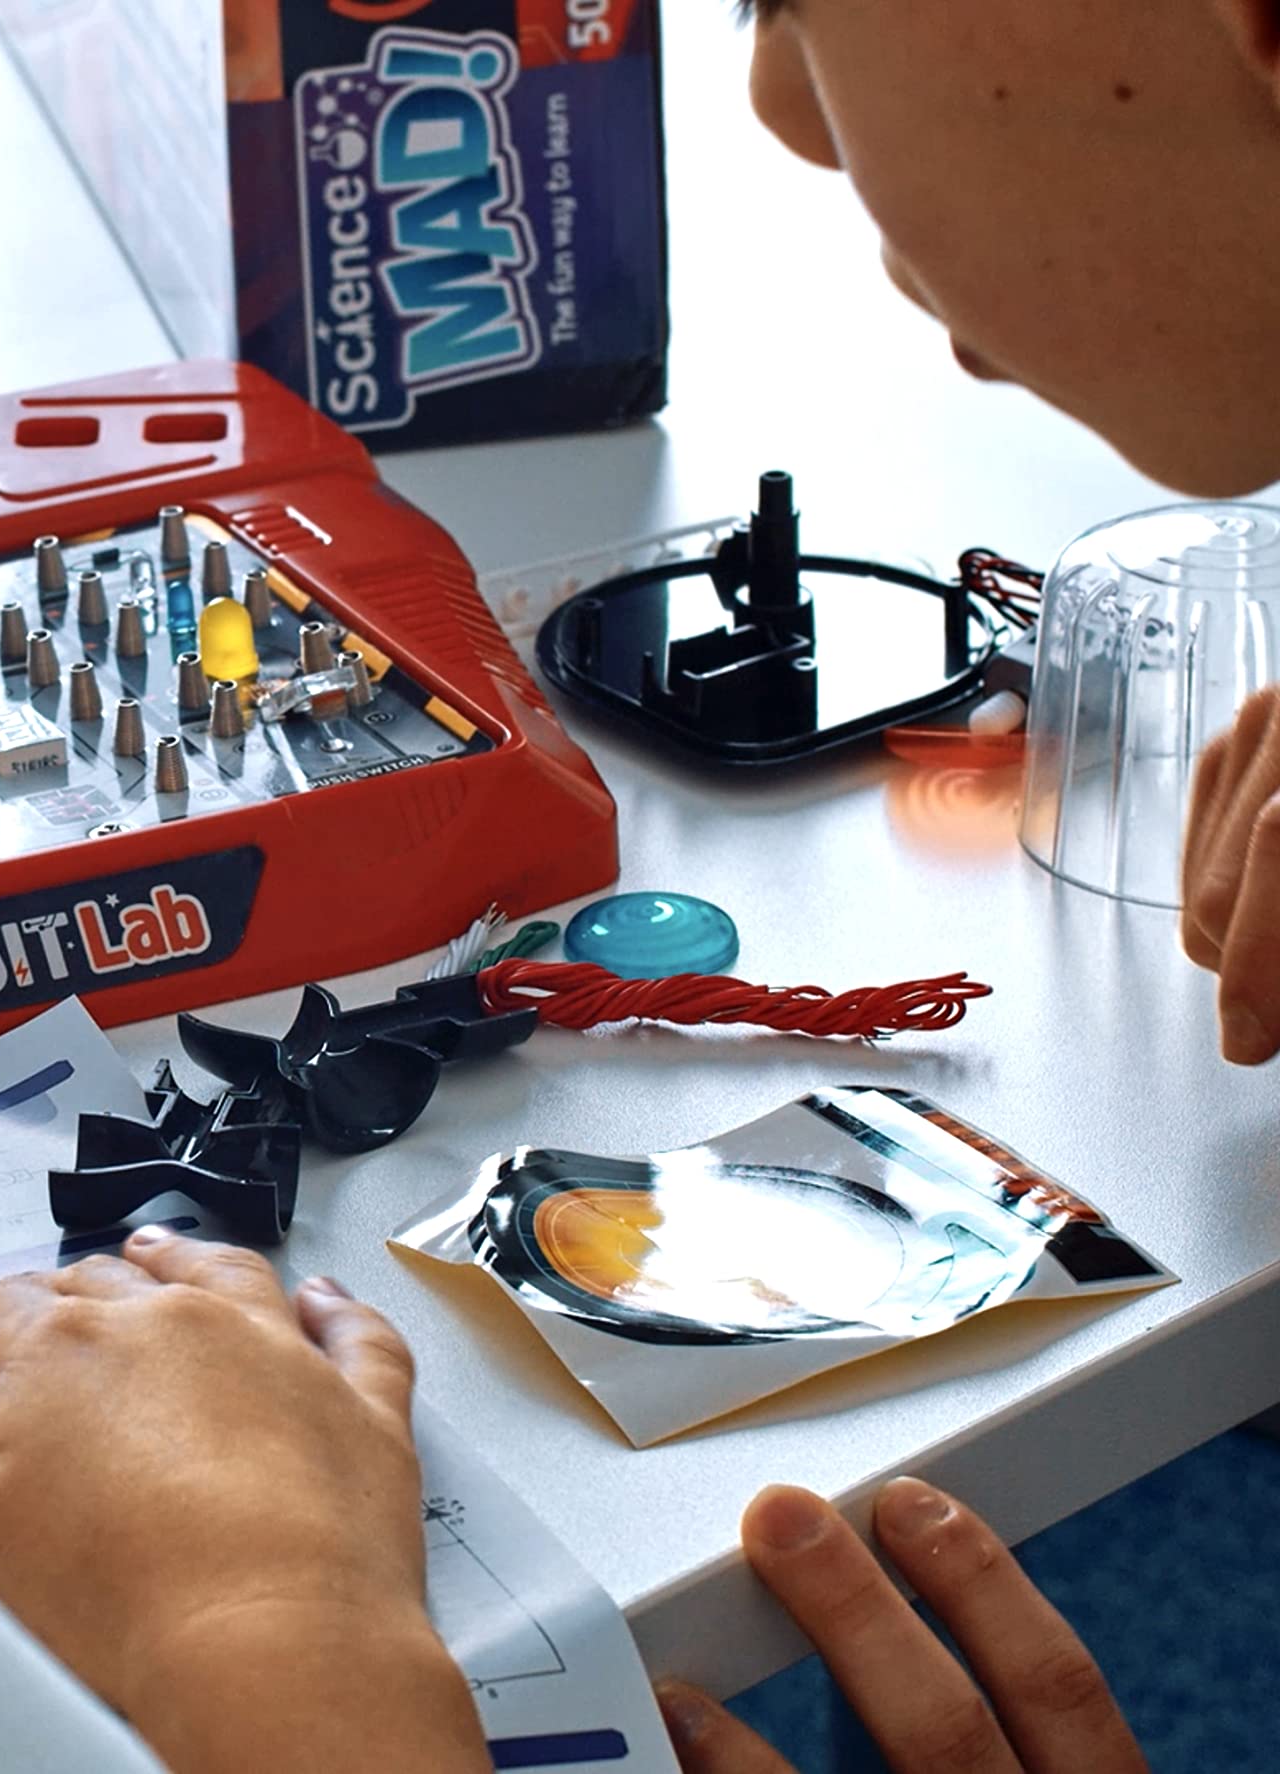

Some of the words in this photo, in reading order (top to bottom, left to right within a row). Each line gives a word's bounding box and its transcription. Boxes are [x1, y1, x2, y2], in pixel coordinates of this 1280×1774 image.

[543, 93, 571, 158] learn
[545, 161, 572, 193] to
[377, 44, 524, 383] MAD!
[552, 196, 577, 248] way
[324, 175, 379, 414] Science
[547, 251, 575, 294] fun
[551, 300, 578, 345] The
[356, 757, 424, 777] SWITCH
[73, 883, 211, 975] Lab
